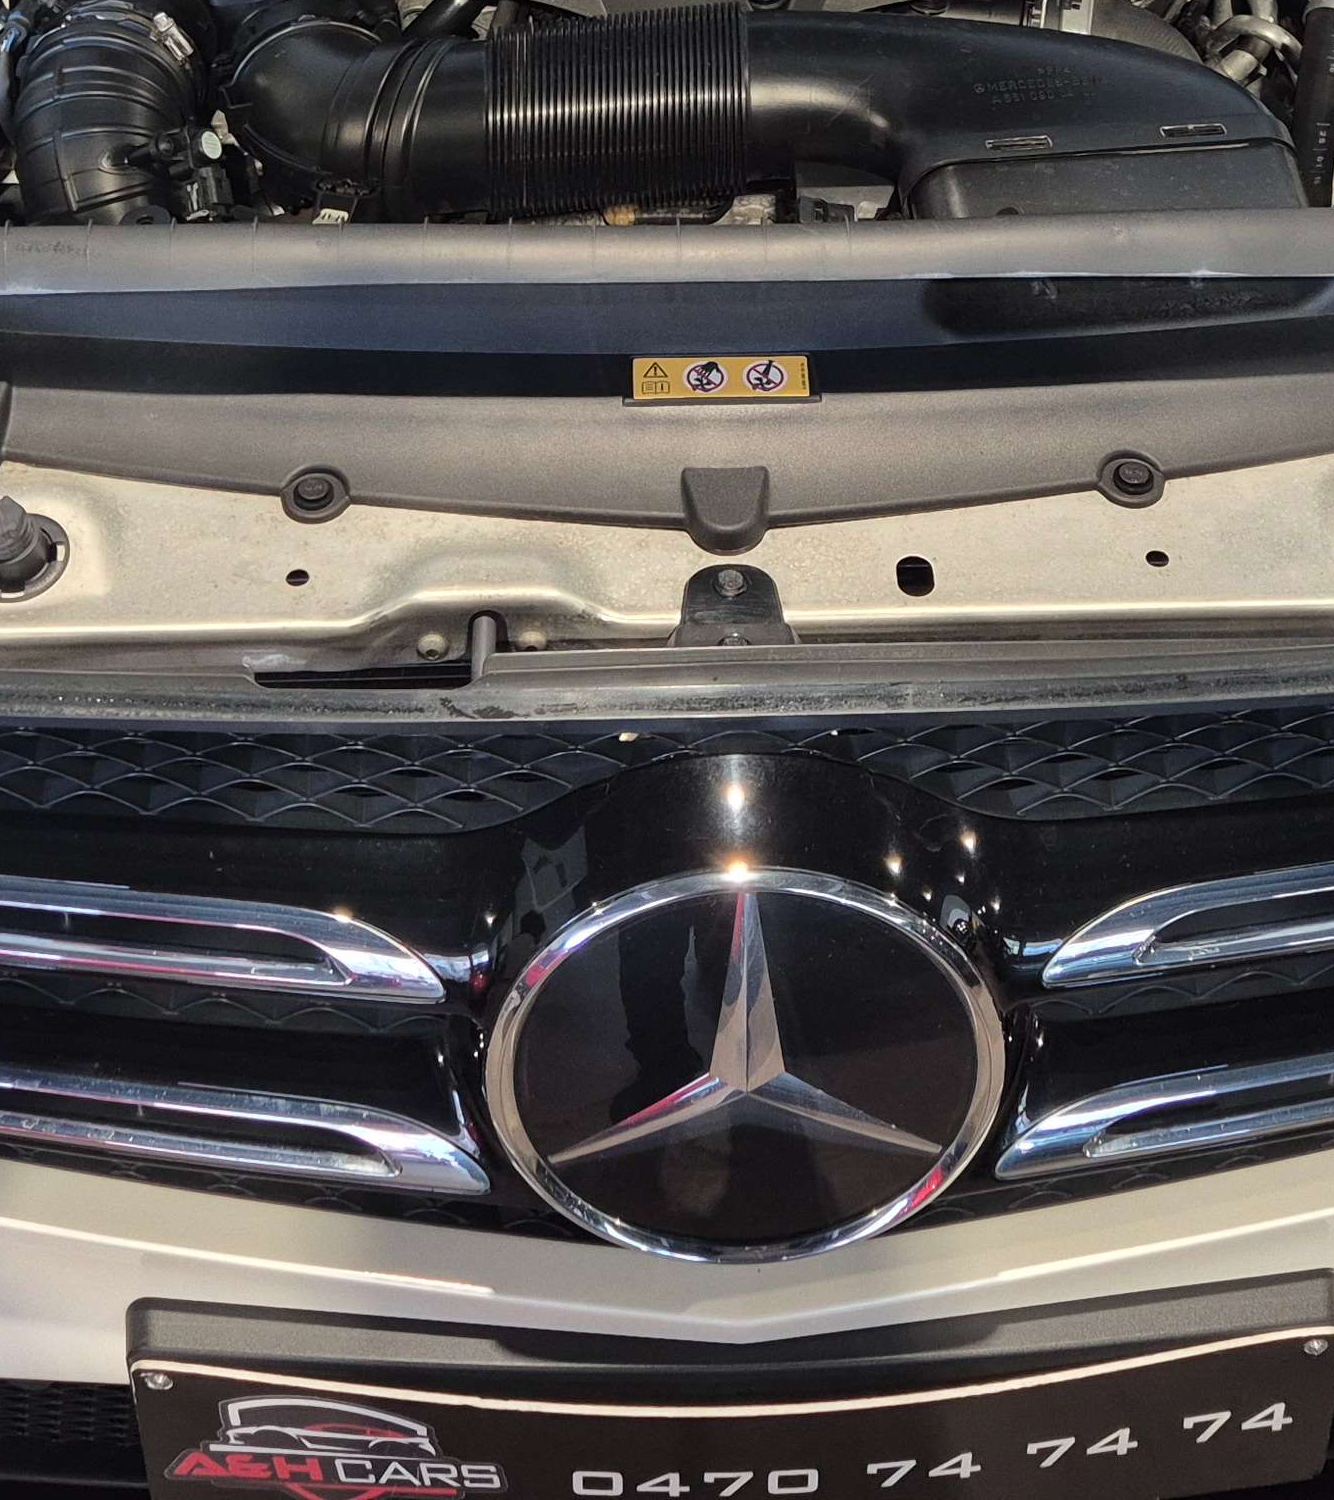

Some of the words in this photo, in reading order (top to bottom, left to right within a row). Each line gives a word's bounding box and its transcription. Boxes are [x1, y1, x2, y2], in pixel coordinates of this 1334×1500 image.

[173, 1451, 323, 1481] A&H
[334, 1457, 501, 1488] CARS
[571, 1468, 820, 1497] 0470
[866, 1452, 981, 1487] 74
[1026, 1427, 1139, 1467] 74
[1183, 1403, 1293, 1443] 74
